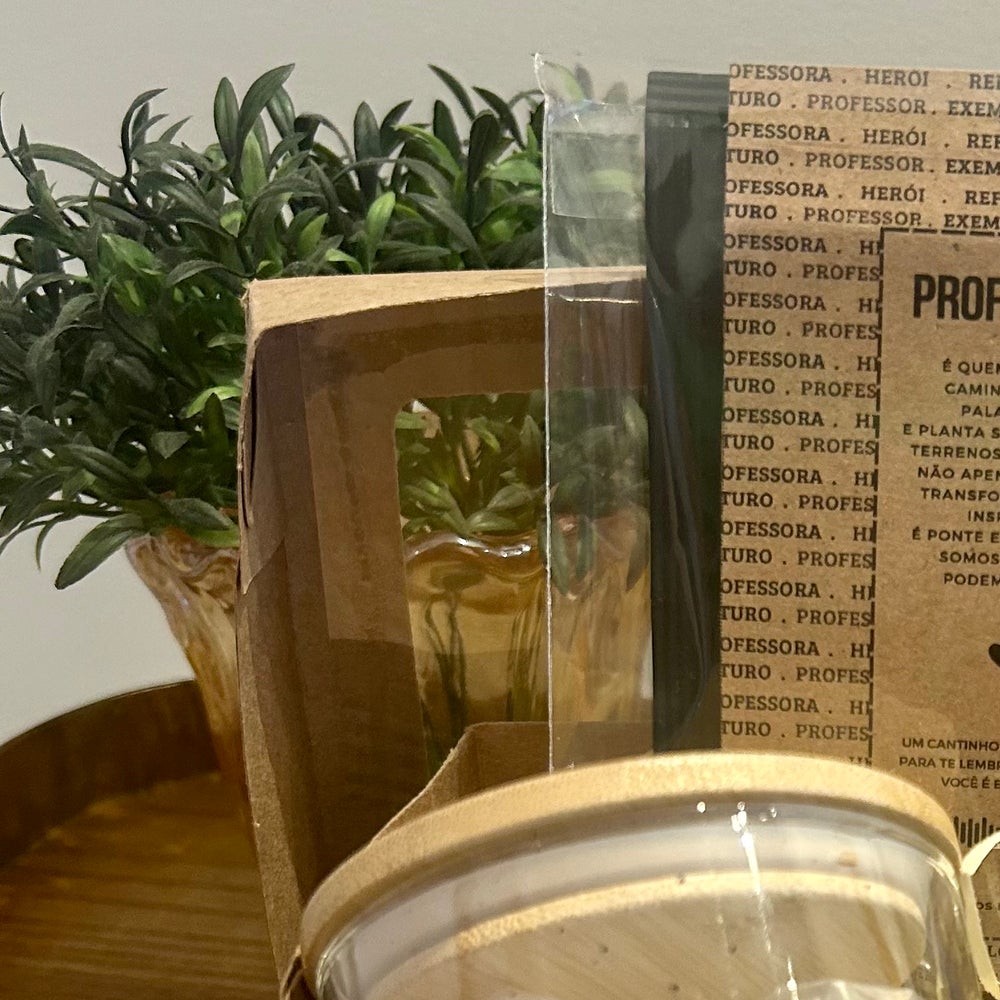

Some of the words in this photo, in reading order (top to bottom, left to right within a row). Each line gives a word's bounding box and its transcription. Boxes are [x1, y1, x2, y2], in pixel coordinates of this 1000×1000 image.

[808, 94, 926, 115] PROFESSOR
[863, 126, 927, 146] HERÓI
[806, 152, 924, 172] PROFESSOR
[861, 183, 925, 203] HERÓI
[804, 206, 922, 226] PROFESSOR
[943, 358, 952, 373] É
[903, 423, 912, 436] E
[919, 424, 985, 438] PLANTA
[917, 464, 955, 480] NÃO
[912, 526, 921, 541] É
[927, 529, 983, 543] PONTE
[939, 551, 1000, 565] SOMOS
[902, 738, 924, 749] UM
[927, 738, 1000, 752] CANTINHO
[899, 756, 936, 768] PARA
[940, 758, 956, 769] TE
[941, 776, 978, 789] VOCÊ
[982, 776, 990, 789] É
